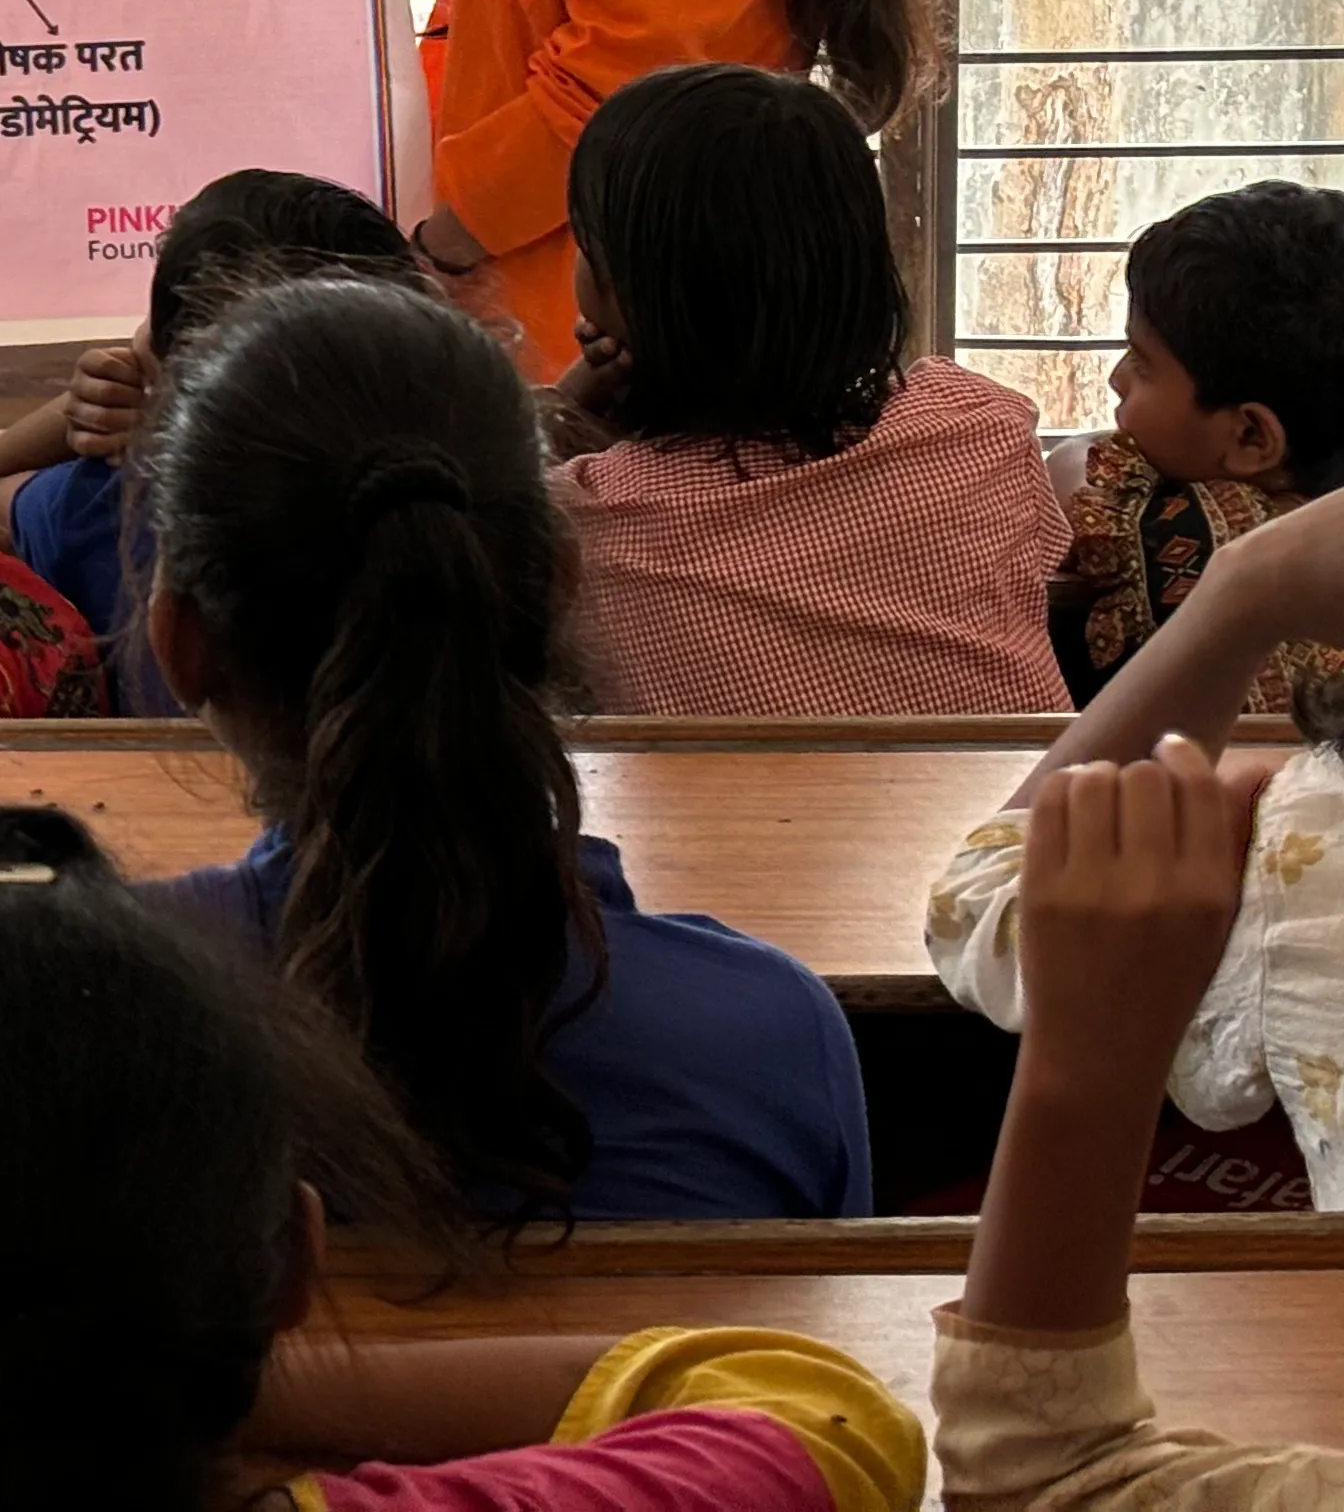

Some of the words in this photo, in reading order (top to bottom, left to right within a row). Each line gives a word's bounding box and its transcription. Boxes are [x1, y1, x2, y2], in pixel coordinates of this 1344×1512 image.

[75, 40, 145, 72] परत
[88, 240, 158, 261] Foun
[1148, 1144, 1313, 1210] afari
